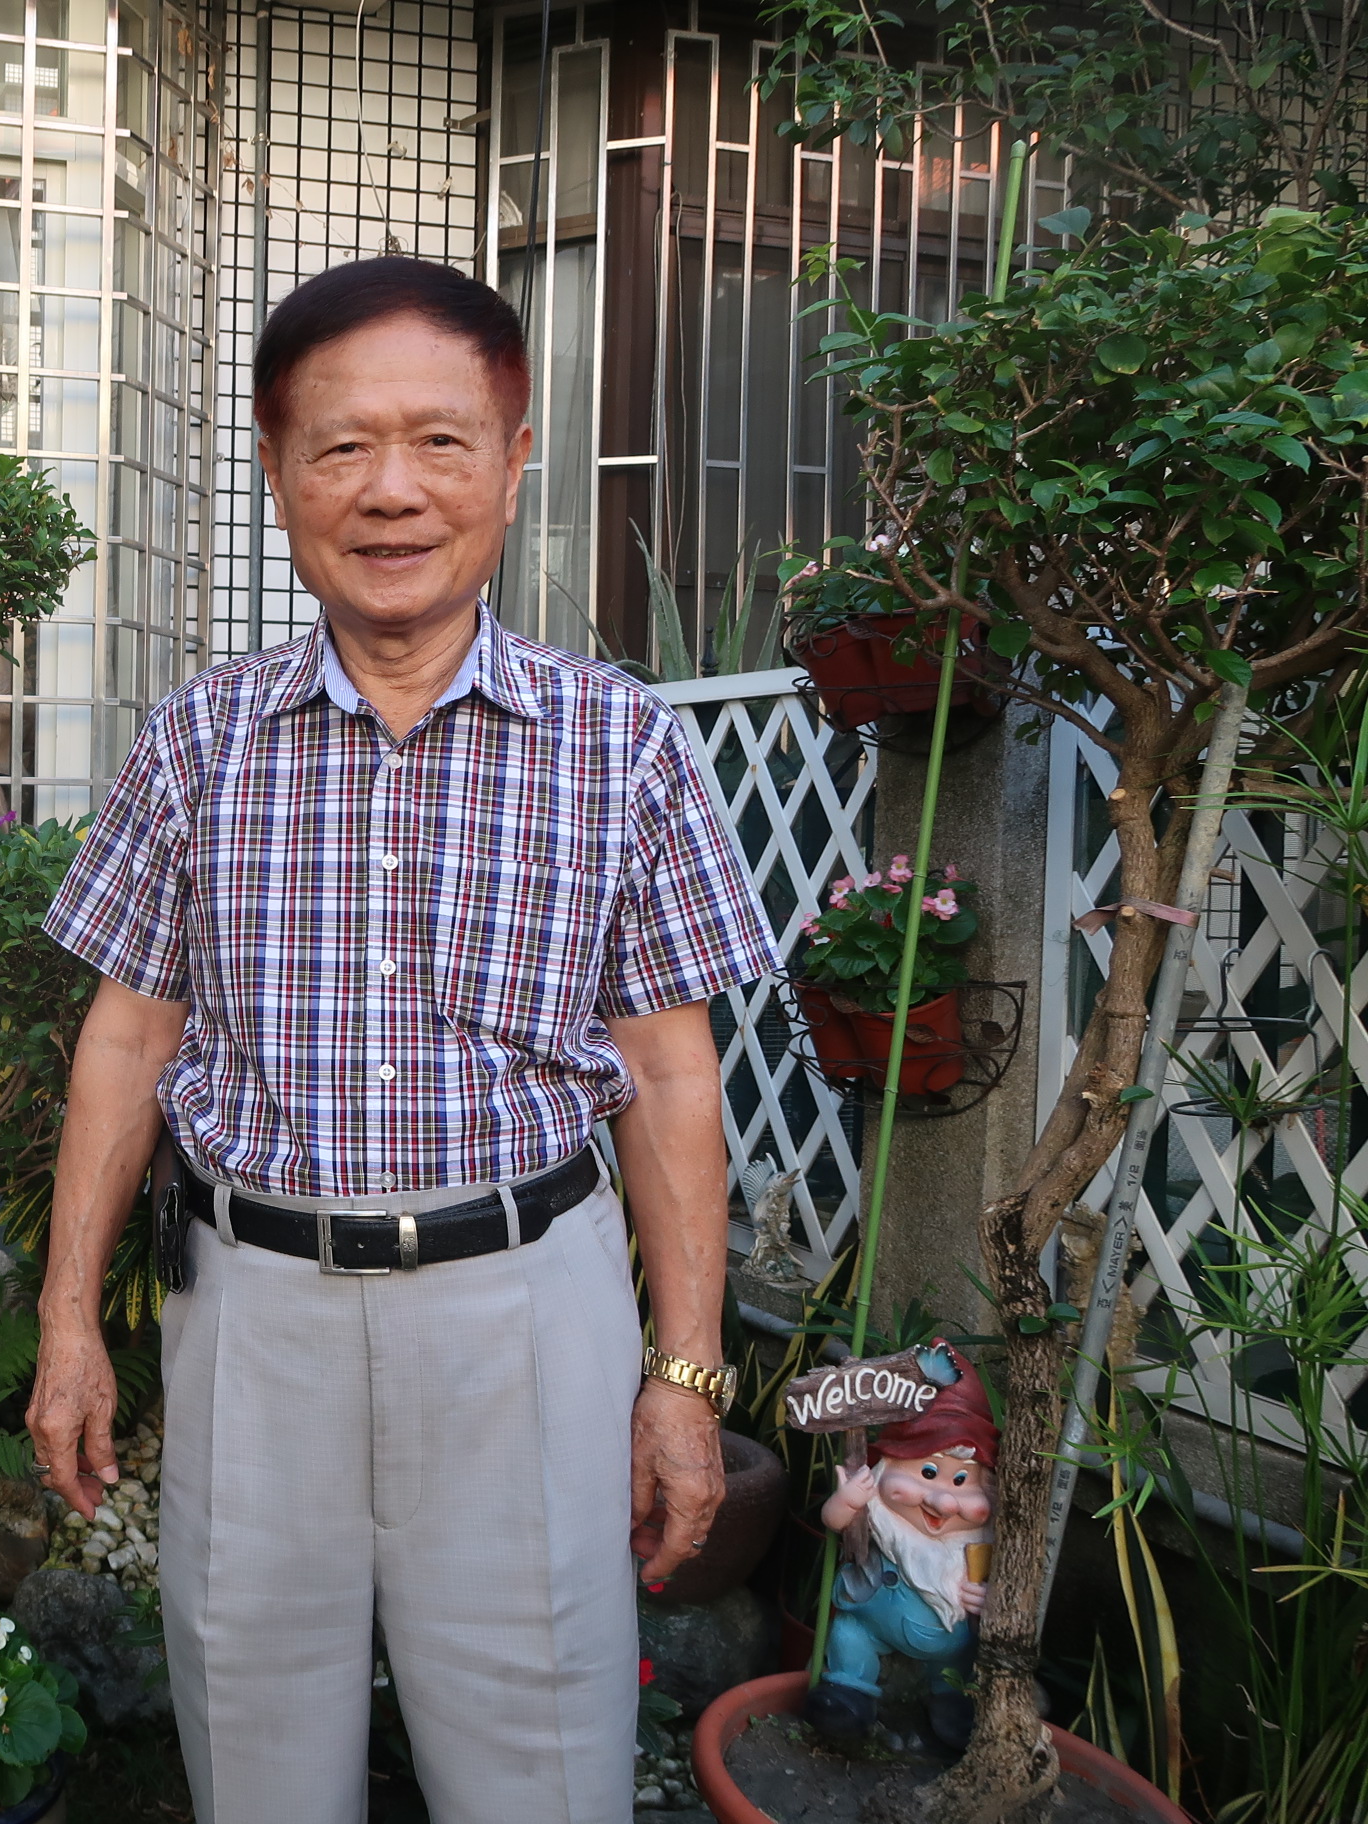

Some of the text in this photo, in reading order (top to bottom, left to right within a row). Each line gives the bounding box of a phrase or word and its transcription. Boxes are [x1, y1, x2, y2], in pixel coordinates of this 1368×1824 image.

[1127, 1164, 1141, 1187] 1/2
[786, 1366, 938, 1426] Welcome
[1050, 1502, 1063, 1524] 1/2
